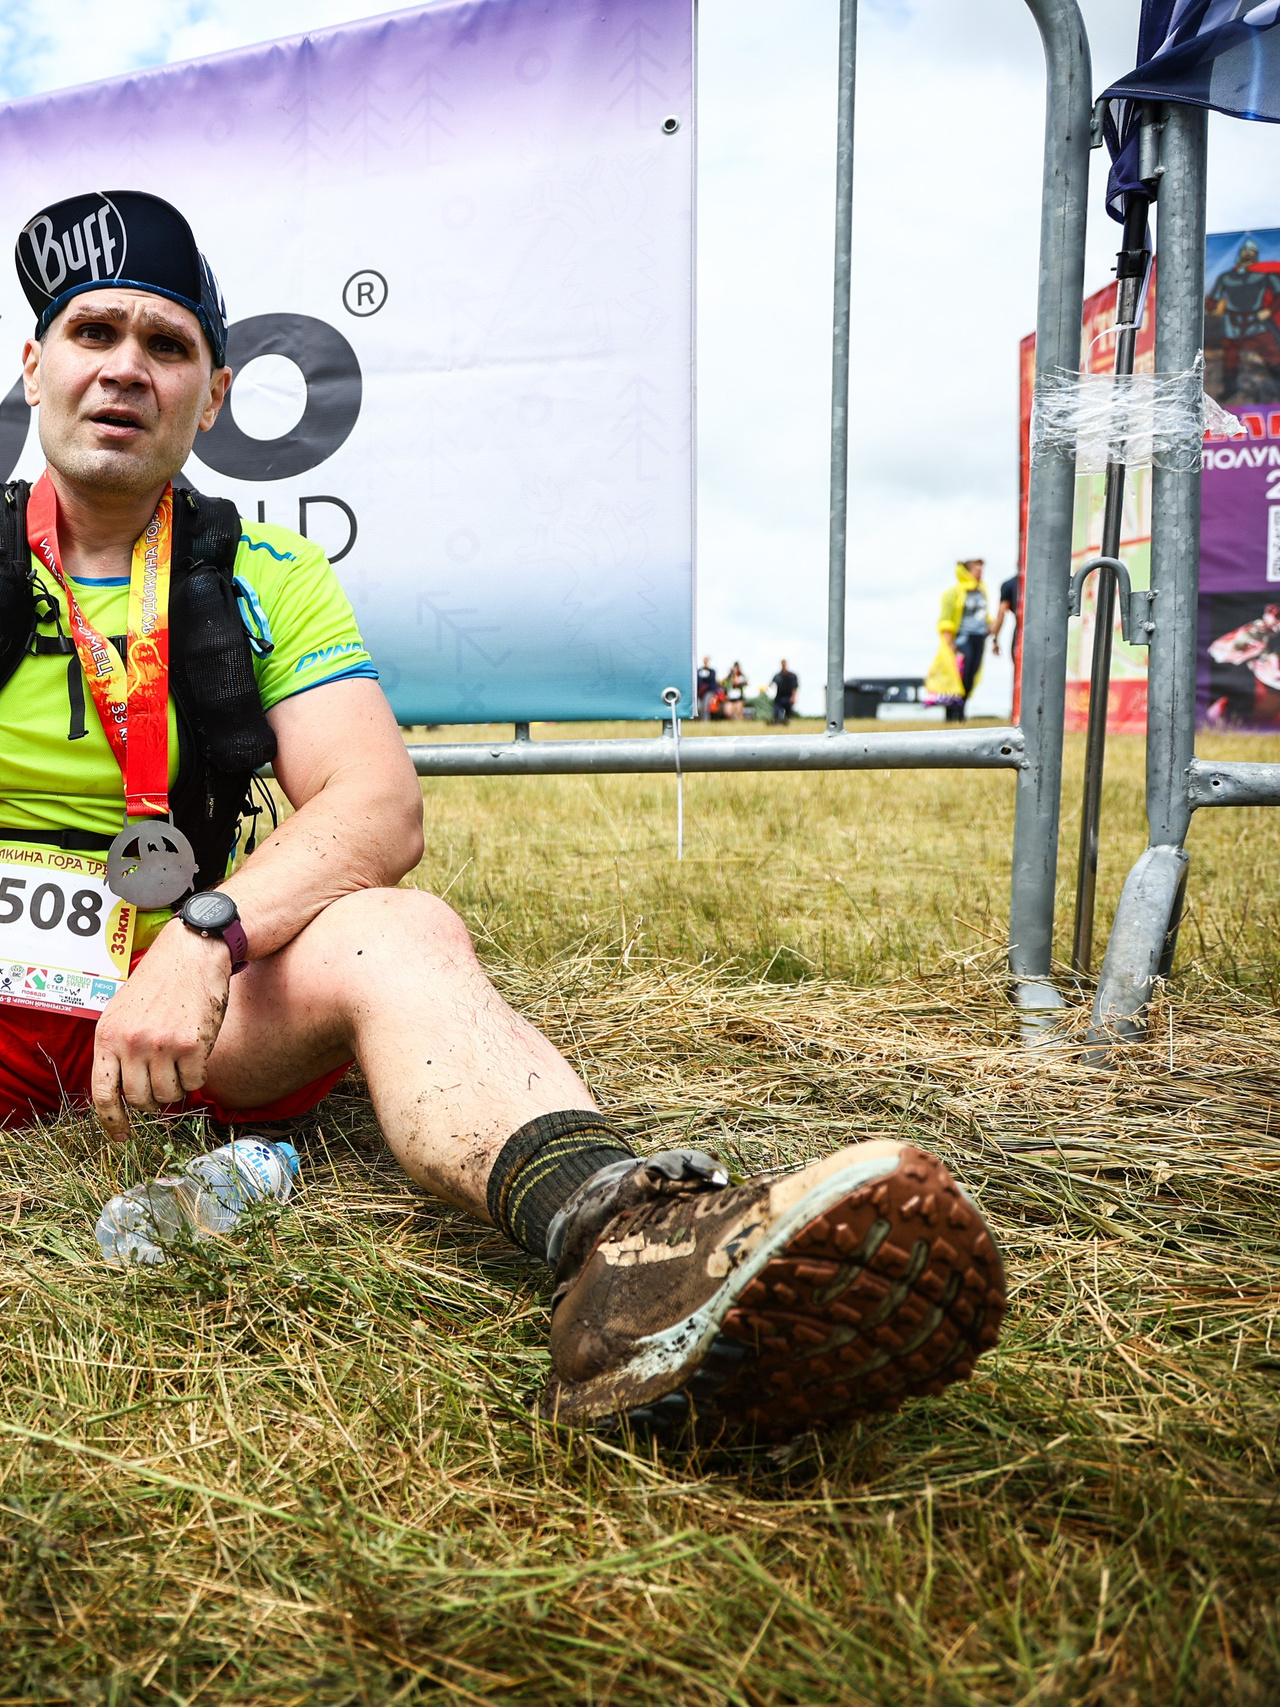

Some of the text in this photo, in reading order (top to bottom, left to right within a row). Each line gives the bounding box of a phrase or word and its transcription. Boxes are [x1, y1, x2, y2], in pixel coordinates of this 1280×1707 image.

[21, 203, 116, 294] Buff
[141, 545, 159, 634] КУДЫКИНА
[111, 702, 127, 724] 33
[47, 854, 83, 871] ГОРА
[86, 860, 108, 876] ТРЕ
[46, 983, 68, 992] СТЕПЬ
[66, 980, 91, 989] SWEET
[34, 1001, 72, 1012] ЭКСТРЕННЫЙ
